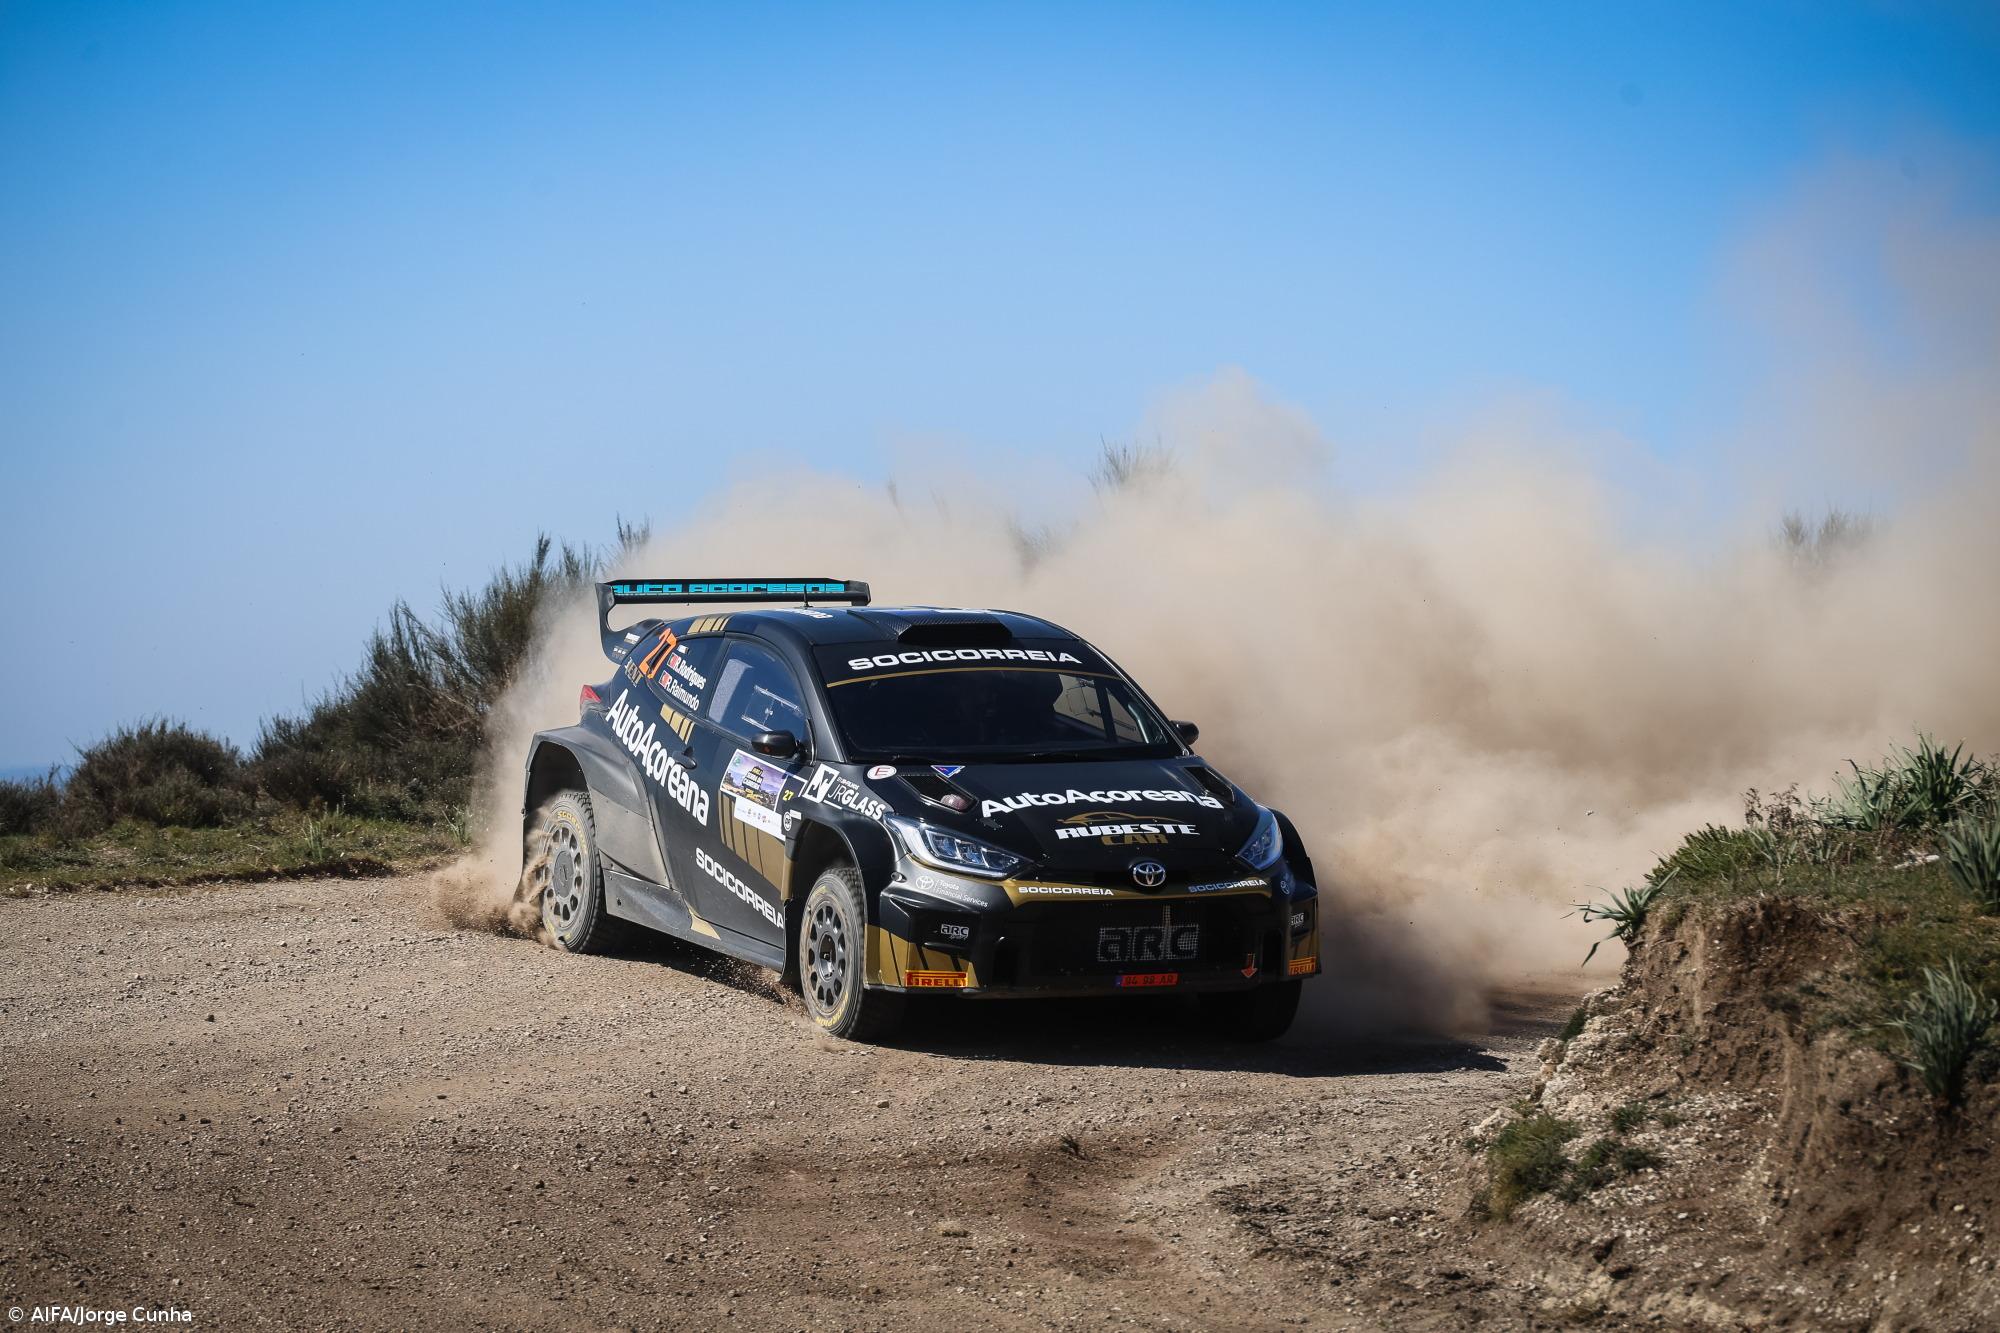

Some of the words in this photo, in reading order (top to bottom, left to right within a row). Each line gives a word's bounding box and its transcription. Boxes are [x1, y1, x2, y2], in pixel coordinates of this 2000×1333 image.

[639, 628, 677, 679] 27
[848, 649, 1082, 670] SOCICORREIA
[783, 789, 794, 801] 27
[1055, 824, 1200, 840] RUBESTE
[1100, 833, 1169, 846] CAR
[696, 847, 785, 930] SOCICORREIA
[939, 881, 960, 890] Toyota
[1018, 886, 1114, 896] SOCICORREIA
[1188, 879, 1268, 893] SOCICORREIA
[936, 888, 962, 900] Financial
[964, 894, 988, 907] Services
[906, 971, 967, 986] PIRELLI
